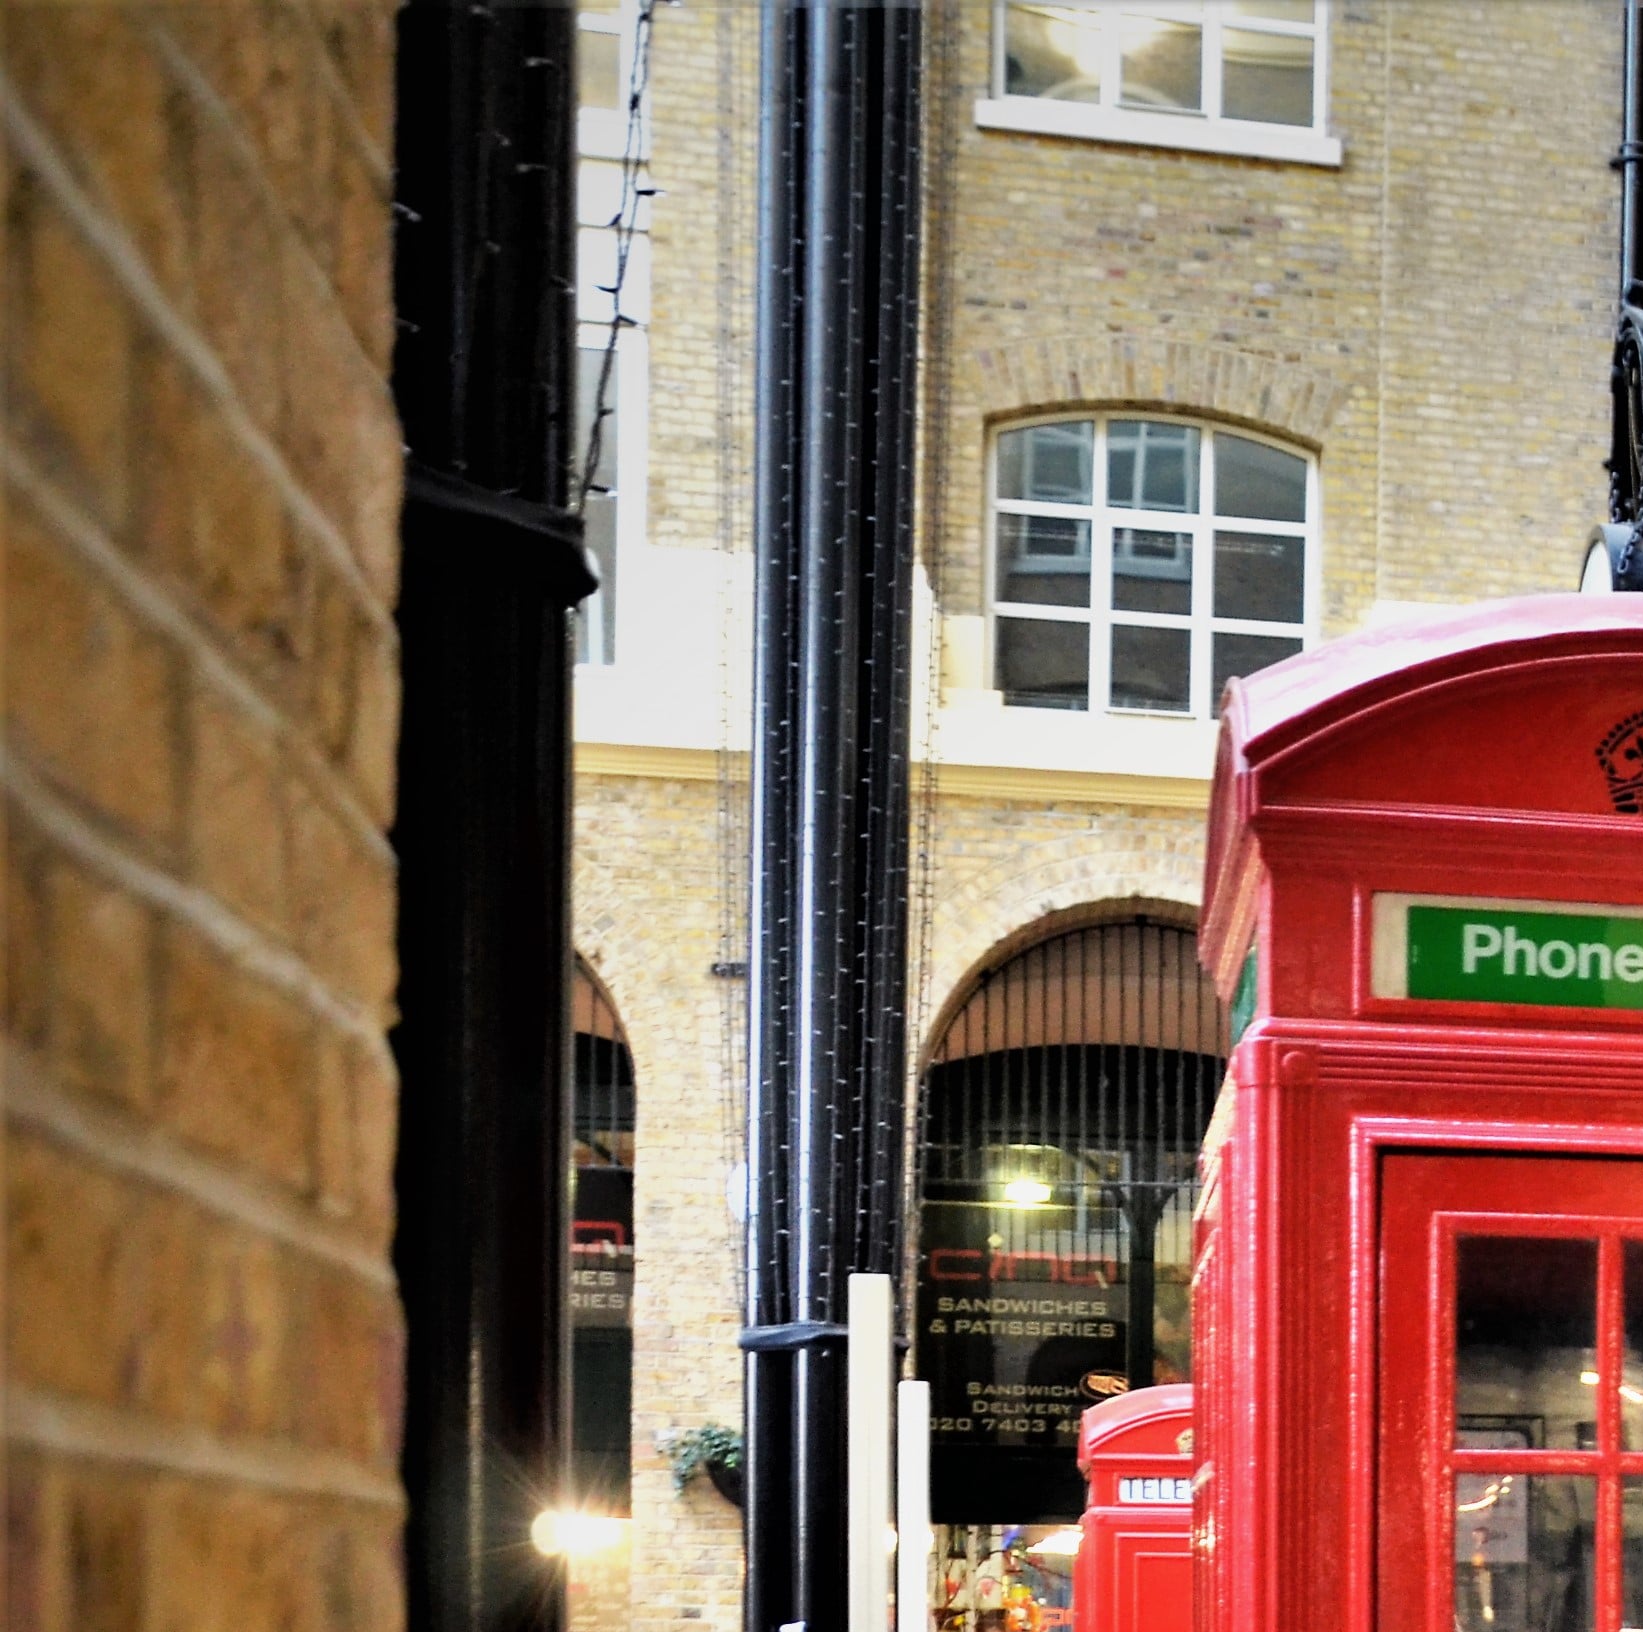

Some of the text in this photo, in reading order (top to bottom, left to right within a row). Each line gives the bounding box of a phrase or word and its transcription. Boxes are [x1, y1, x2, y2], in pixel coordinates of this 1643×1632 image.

[937, 1296, 1108, 1316] SANDWICHES
[929, 1319, 1116, 1338] & PATISSERIES
[981, 1418, 1047, 1433] 7403
